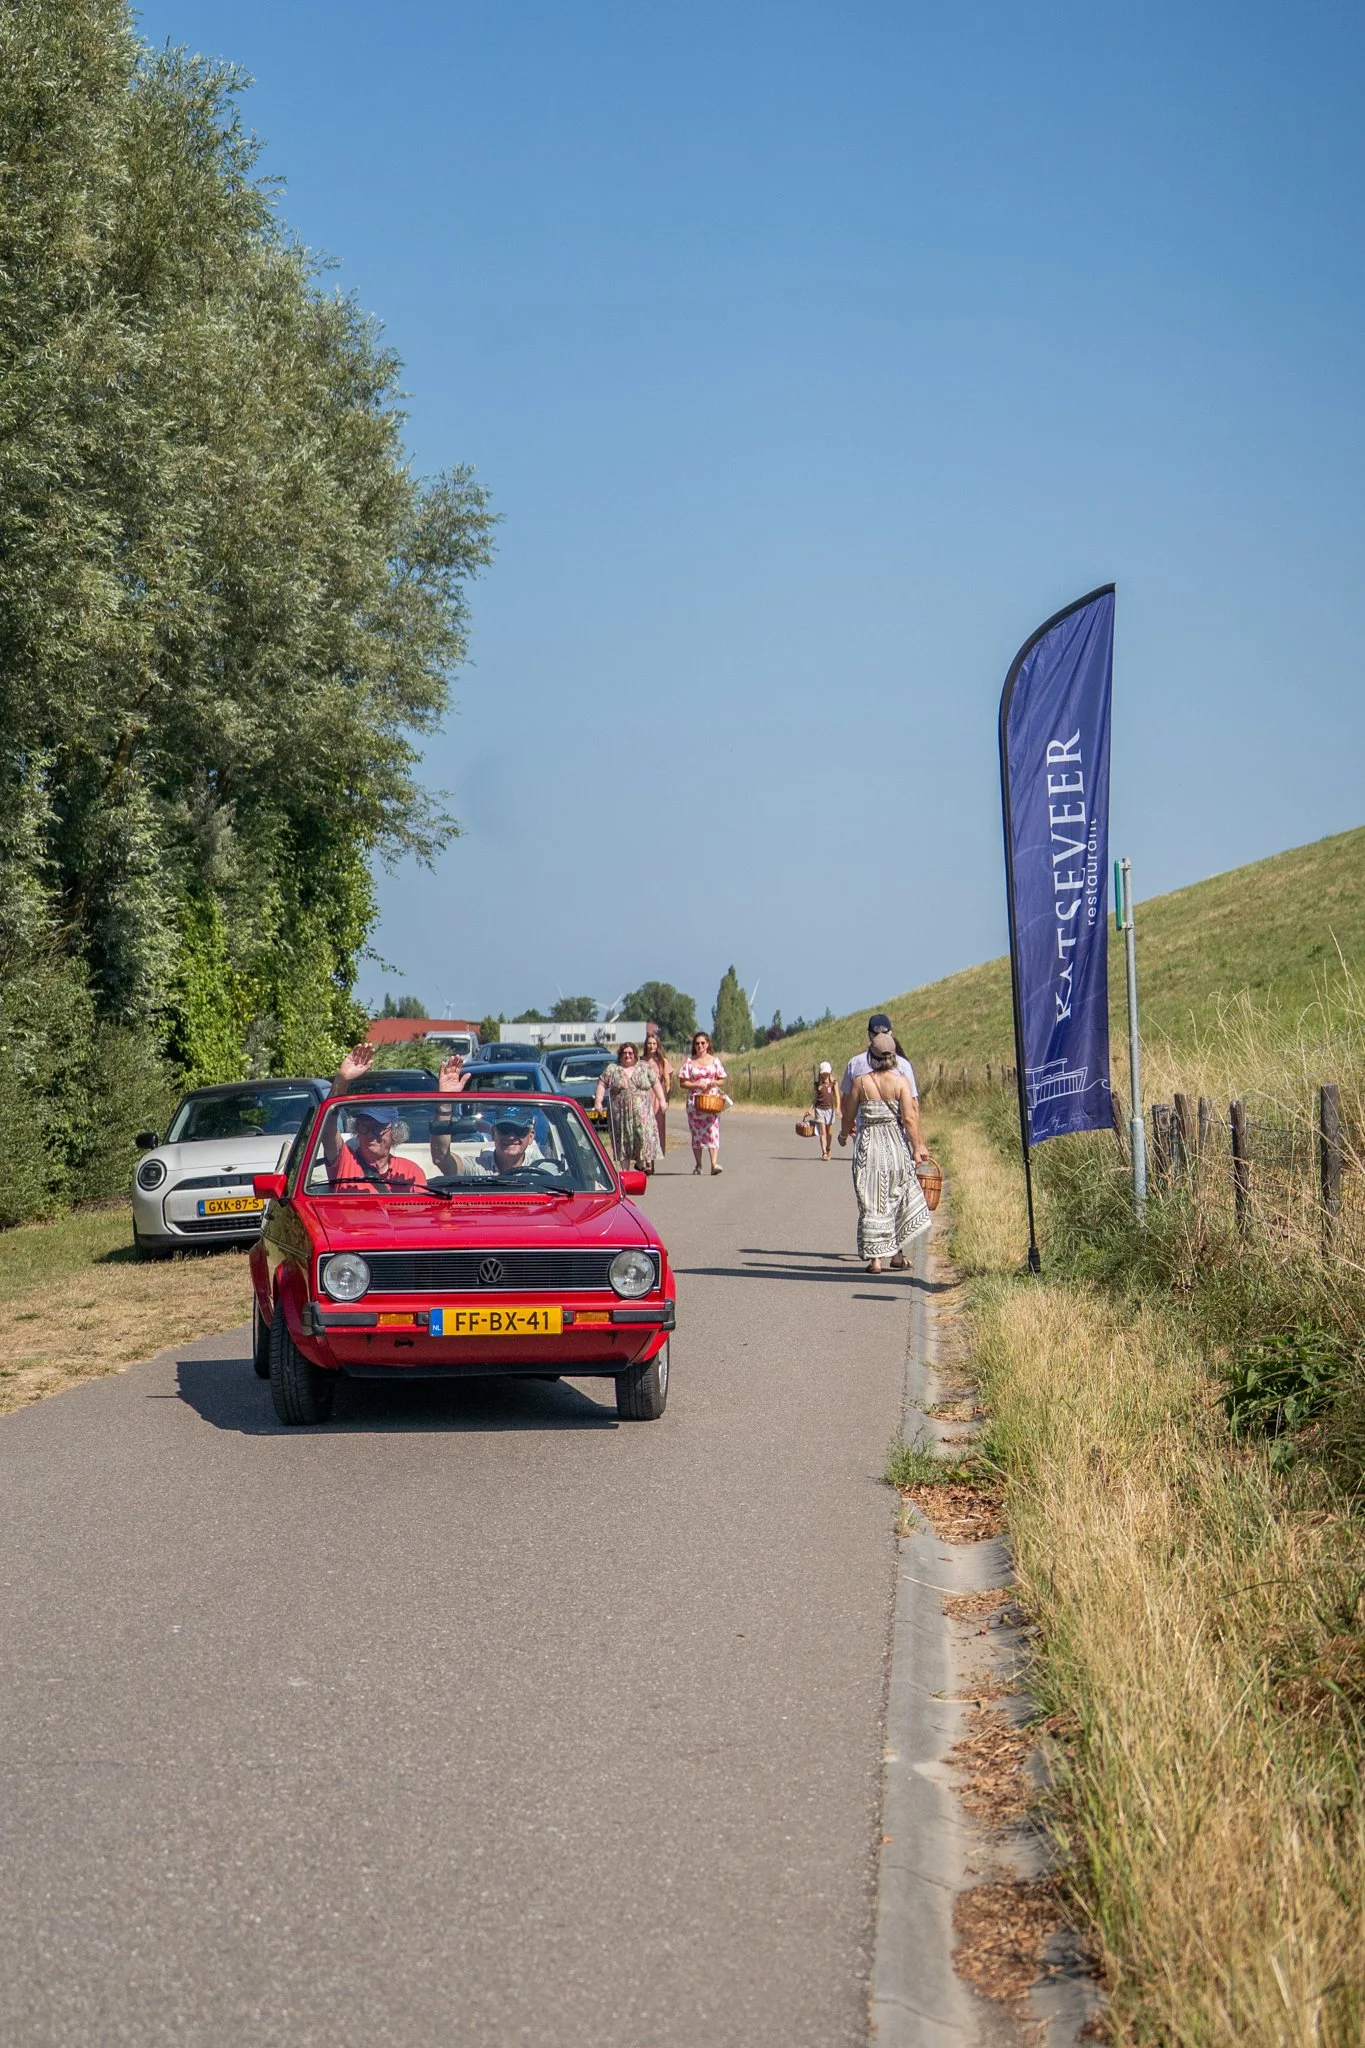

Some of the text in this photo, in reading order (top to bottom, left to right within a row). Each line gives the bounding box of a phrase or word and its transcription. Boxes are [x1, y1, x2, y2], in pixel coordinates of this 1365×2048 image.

[1046, 728, 1086, 1025] KATSEVEER
[208, 1198, 260, 1212] GXK-87-S
[455, 1311, 549, 1331] FF-BX-41
